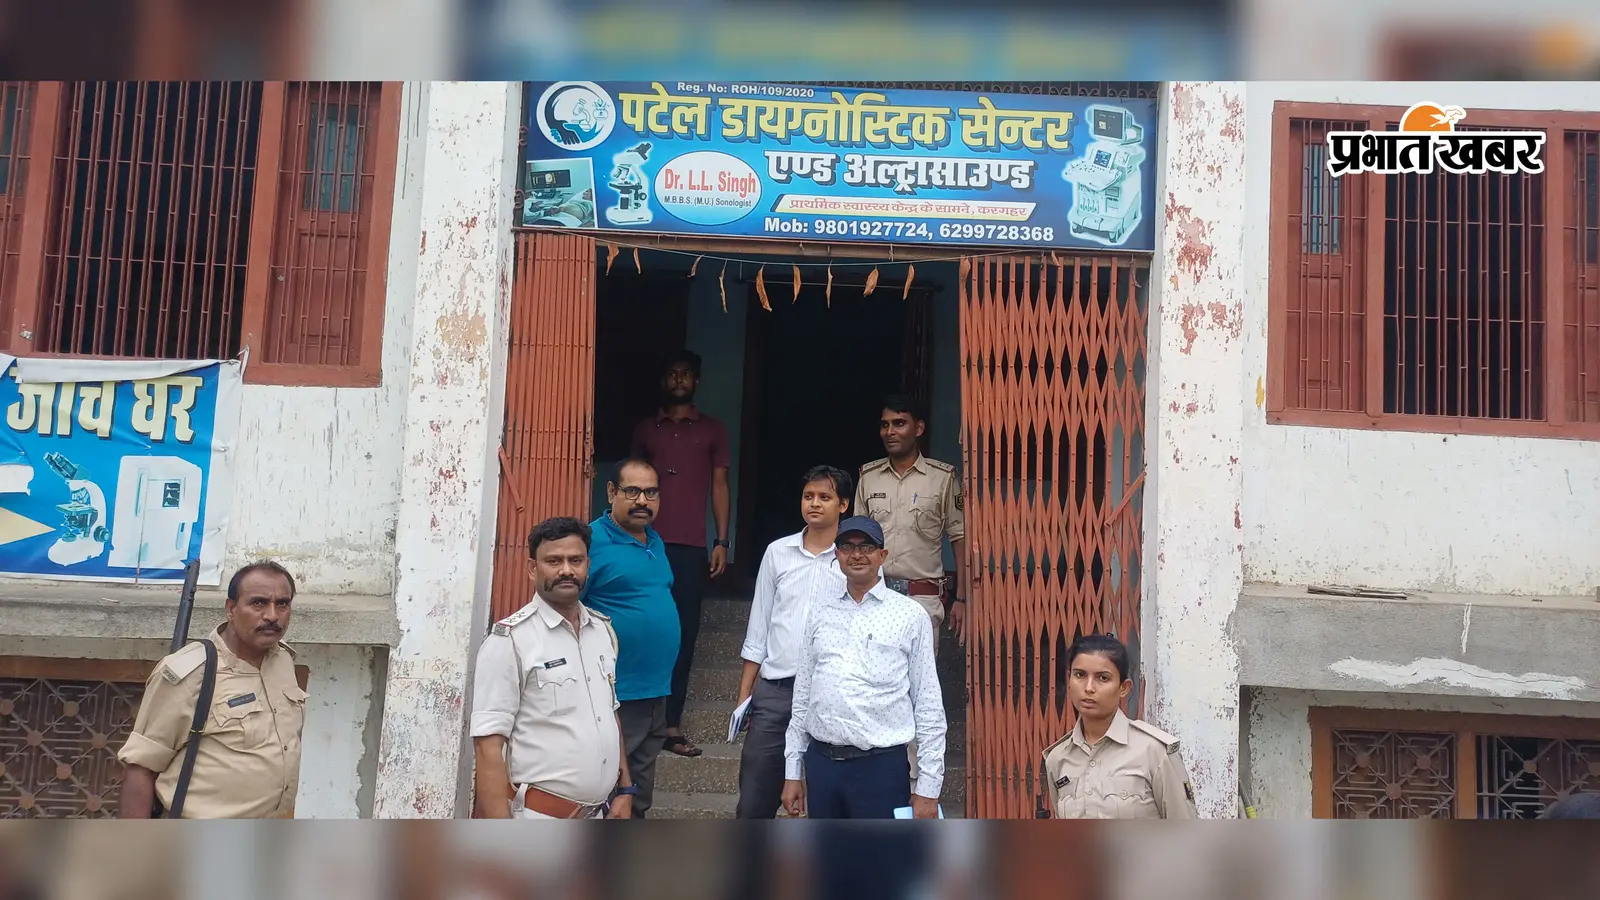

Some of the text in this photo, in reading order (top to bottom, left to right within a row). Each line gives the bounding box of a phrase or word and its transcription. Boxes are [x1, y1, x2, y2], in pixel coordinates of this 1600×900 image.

[677, 82, 814, 98] Reg. No: ROH/109/2020
[619, 82, 1073, 150] पटेल डायग्नोस्टिक सेन्टर
[664, 168, 756, 198] Dr. L.L. Singh
[764, 151, 1034, 192] एण्ड अल्ट्रासाउण्ड
[664, 195, 752, 208] M.B.B.S. (M.U.) Sonologist
[789, 198, 841, 210] प्राथमिक
[842, 201, 889, 212] स्वास्थ्य
[891, 200, 918, 214] केन्द्र
[920, 202, 933, 212] के
[978, 206, 1028, 216] करगहर
[765, 217, 1054, 241] Mob: 9801927724, 6299728368
[131, 376, 203, 441] घर
